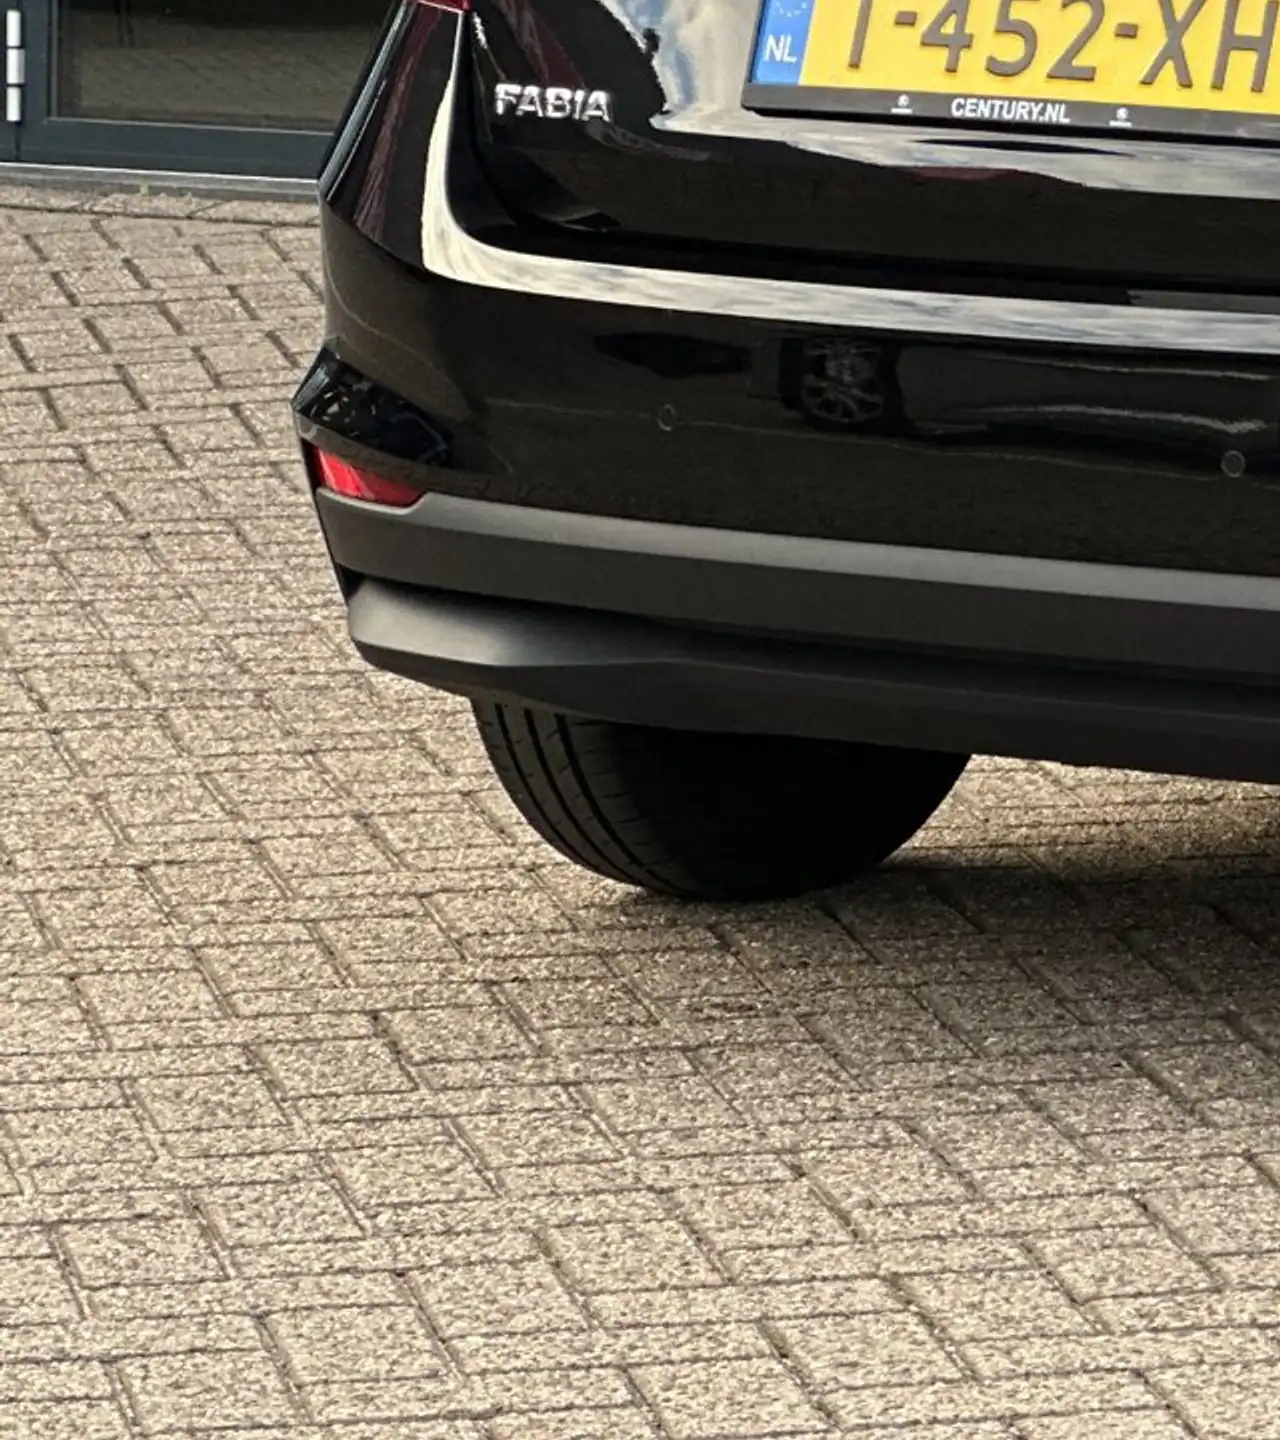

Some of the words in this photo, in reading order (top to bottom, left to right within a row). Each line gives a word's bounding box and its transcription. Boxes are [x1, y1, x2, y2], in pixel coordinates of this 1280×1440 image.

[764, 33, 798, 63] NL
[495, 83, 611, 123] FABIA
[951, 98, 1071, 123] CENTURY.NL
